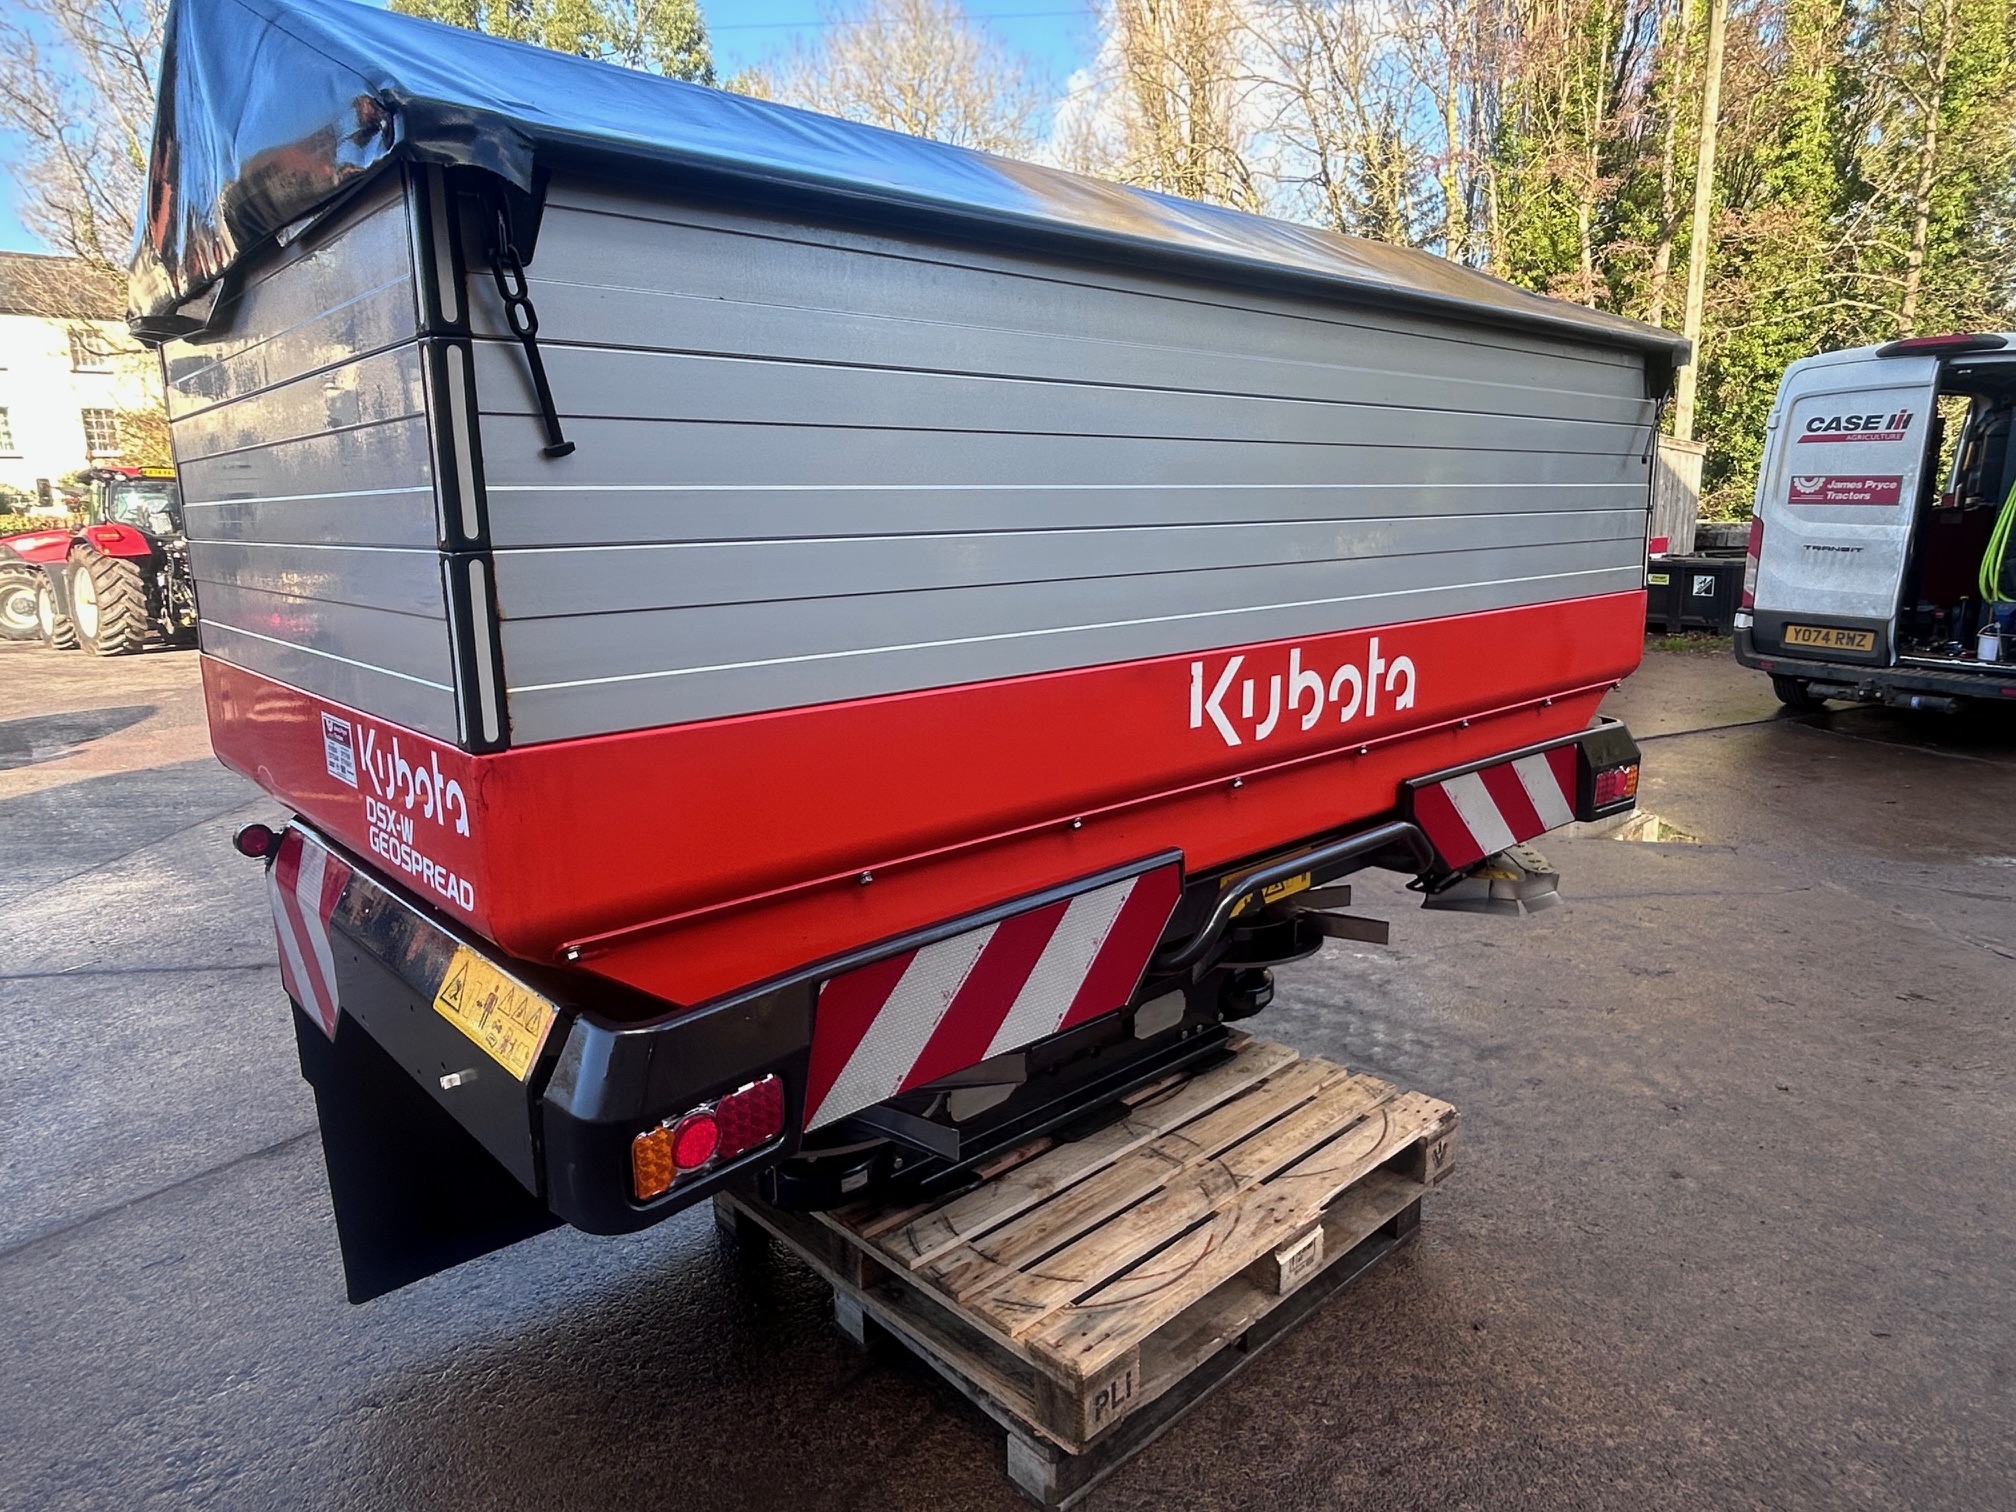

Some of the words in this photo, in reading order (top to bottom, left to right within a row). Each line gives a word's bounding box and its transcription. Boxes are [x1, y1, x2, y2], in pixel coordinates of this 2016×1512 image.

[1806, 414, 1884, 432] CASE
[1845, 433, 1901, 441] AGRICULTURE
[1827, 480, 1861, 489] James
[1864, 480, 1898, 490] Pryce
[1826, 491, 1871, 500] Tractors
[1835, 632, 1867, 647] RWZ
[1190, 637, 1416, 746] Kubota
[356, 724, 470, 837] Kubota
[365, 795, 413, 845] DSX-W
[369, 827, 474, 912] GEOSPREAD
